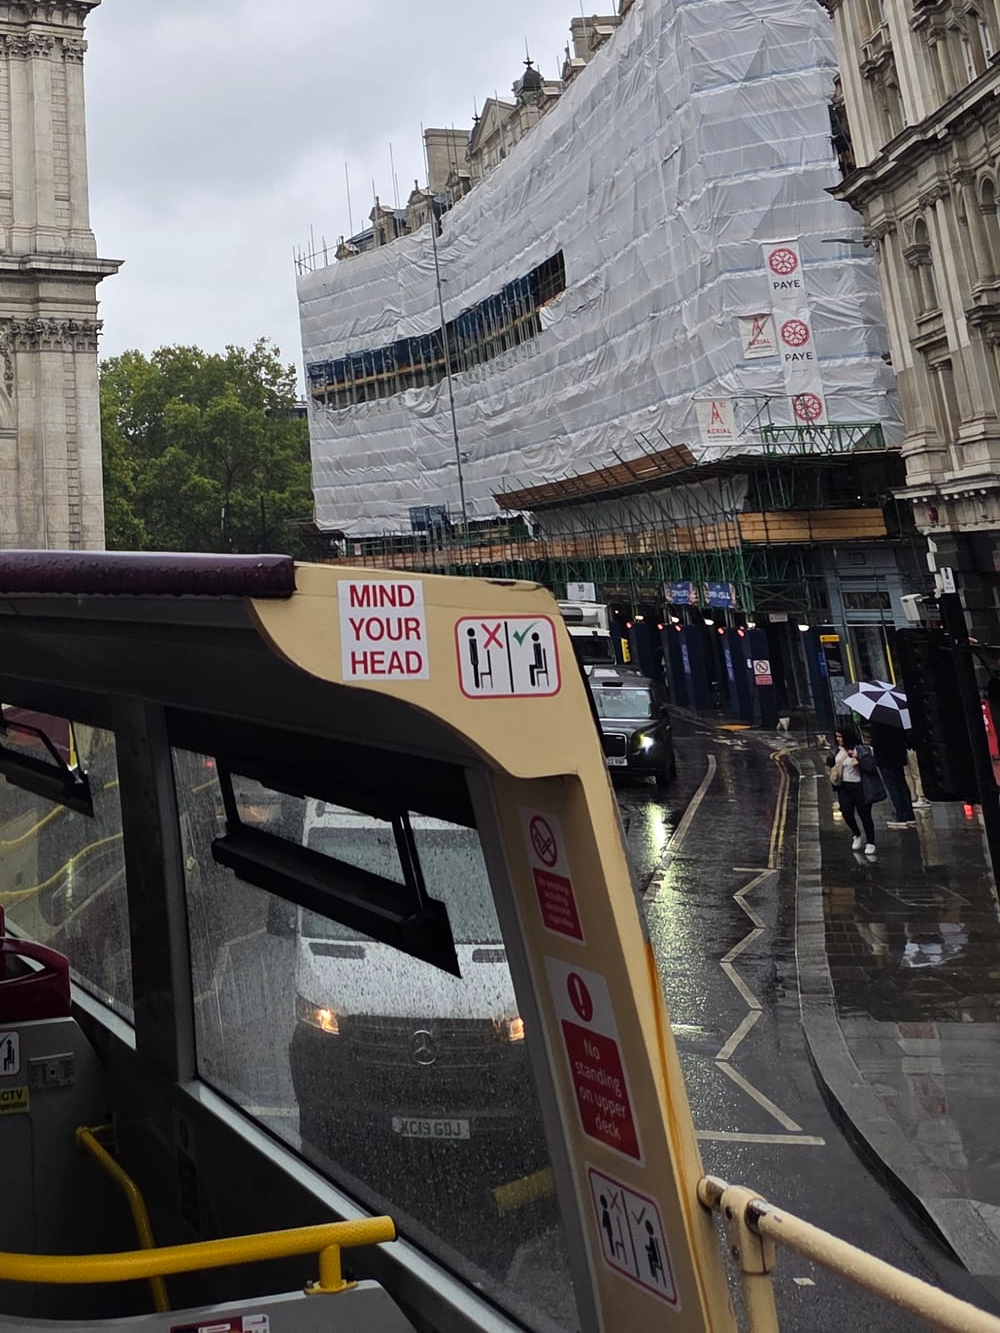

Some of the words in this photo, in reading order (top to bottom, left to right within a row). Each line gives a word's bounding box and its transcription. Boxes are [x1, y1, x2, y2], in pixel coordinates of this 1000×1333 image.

[773, 279, 801, 290] PAYE
[785, 351, 814, 362] PAYE
[706, 427, 732, 435] AERIAL
[349, 584, 415, 608] MIND
[348, 616, 422, 641] YOUR
[350, 650, 423, 675] HEAD
[583, 1038, 600, 1060] No
[574, 1061, 622, 1098] standing
[579, 1085, 594, 1103] on
[593, 1091, 626, 1118] upper
[595, 1114, 621, 1141] deck
